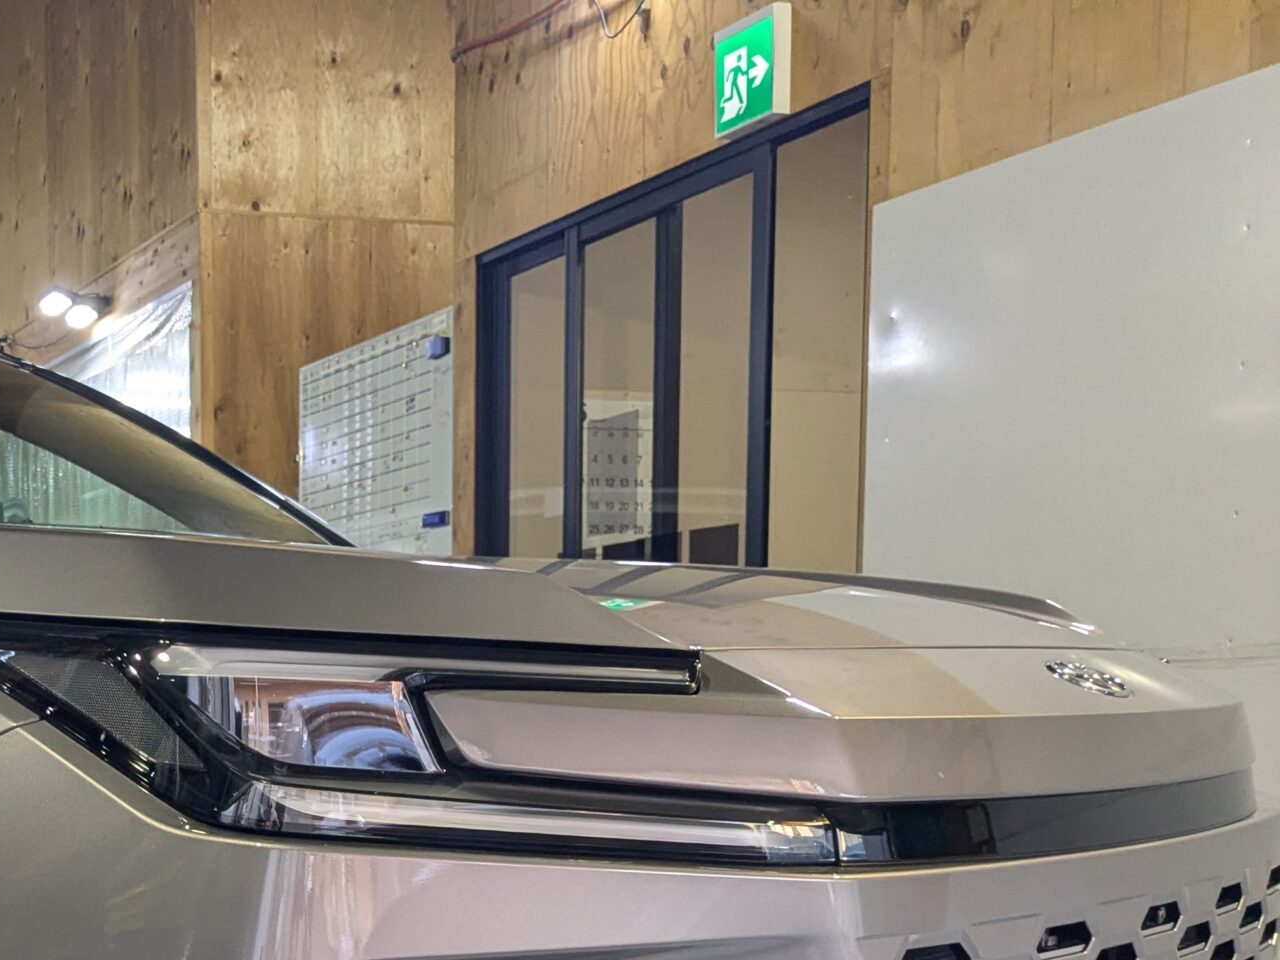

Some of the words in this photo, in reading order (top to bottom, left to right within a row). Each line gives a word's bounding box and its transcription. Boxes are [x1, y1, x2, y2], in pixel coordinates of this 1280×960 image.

[607, 455, 613, 464] 5
[590, 478, 600, 487] 11
[605, 478, 615, 487] 12
